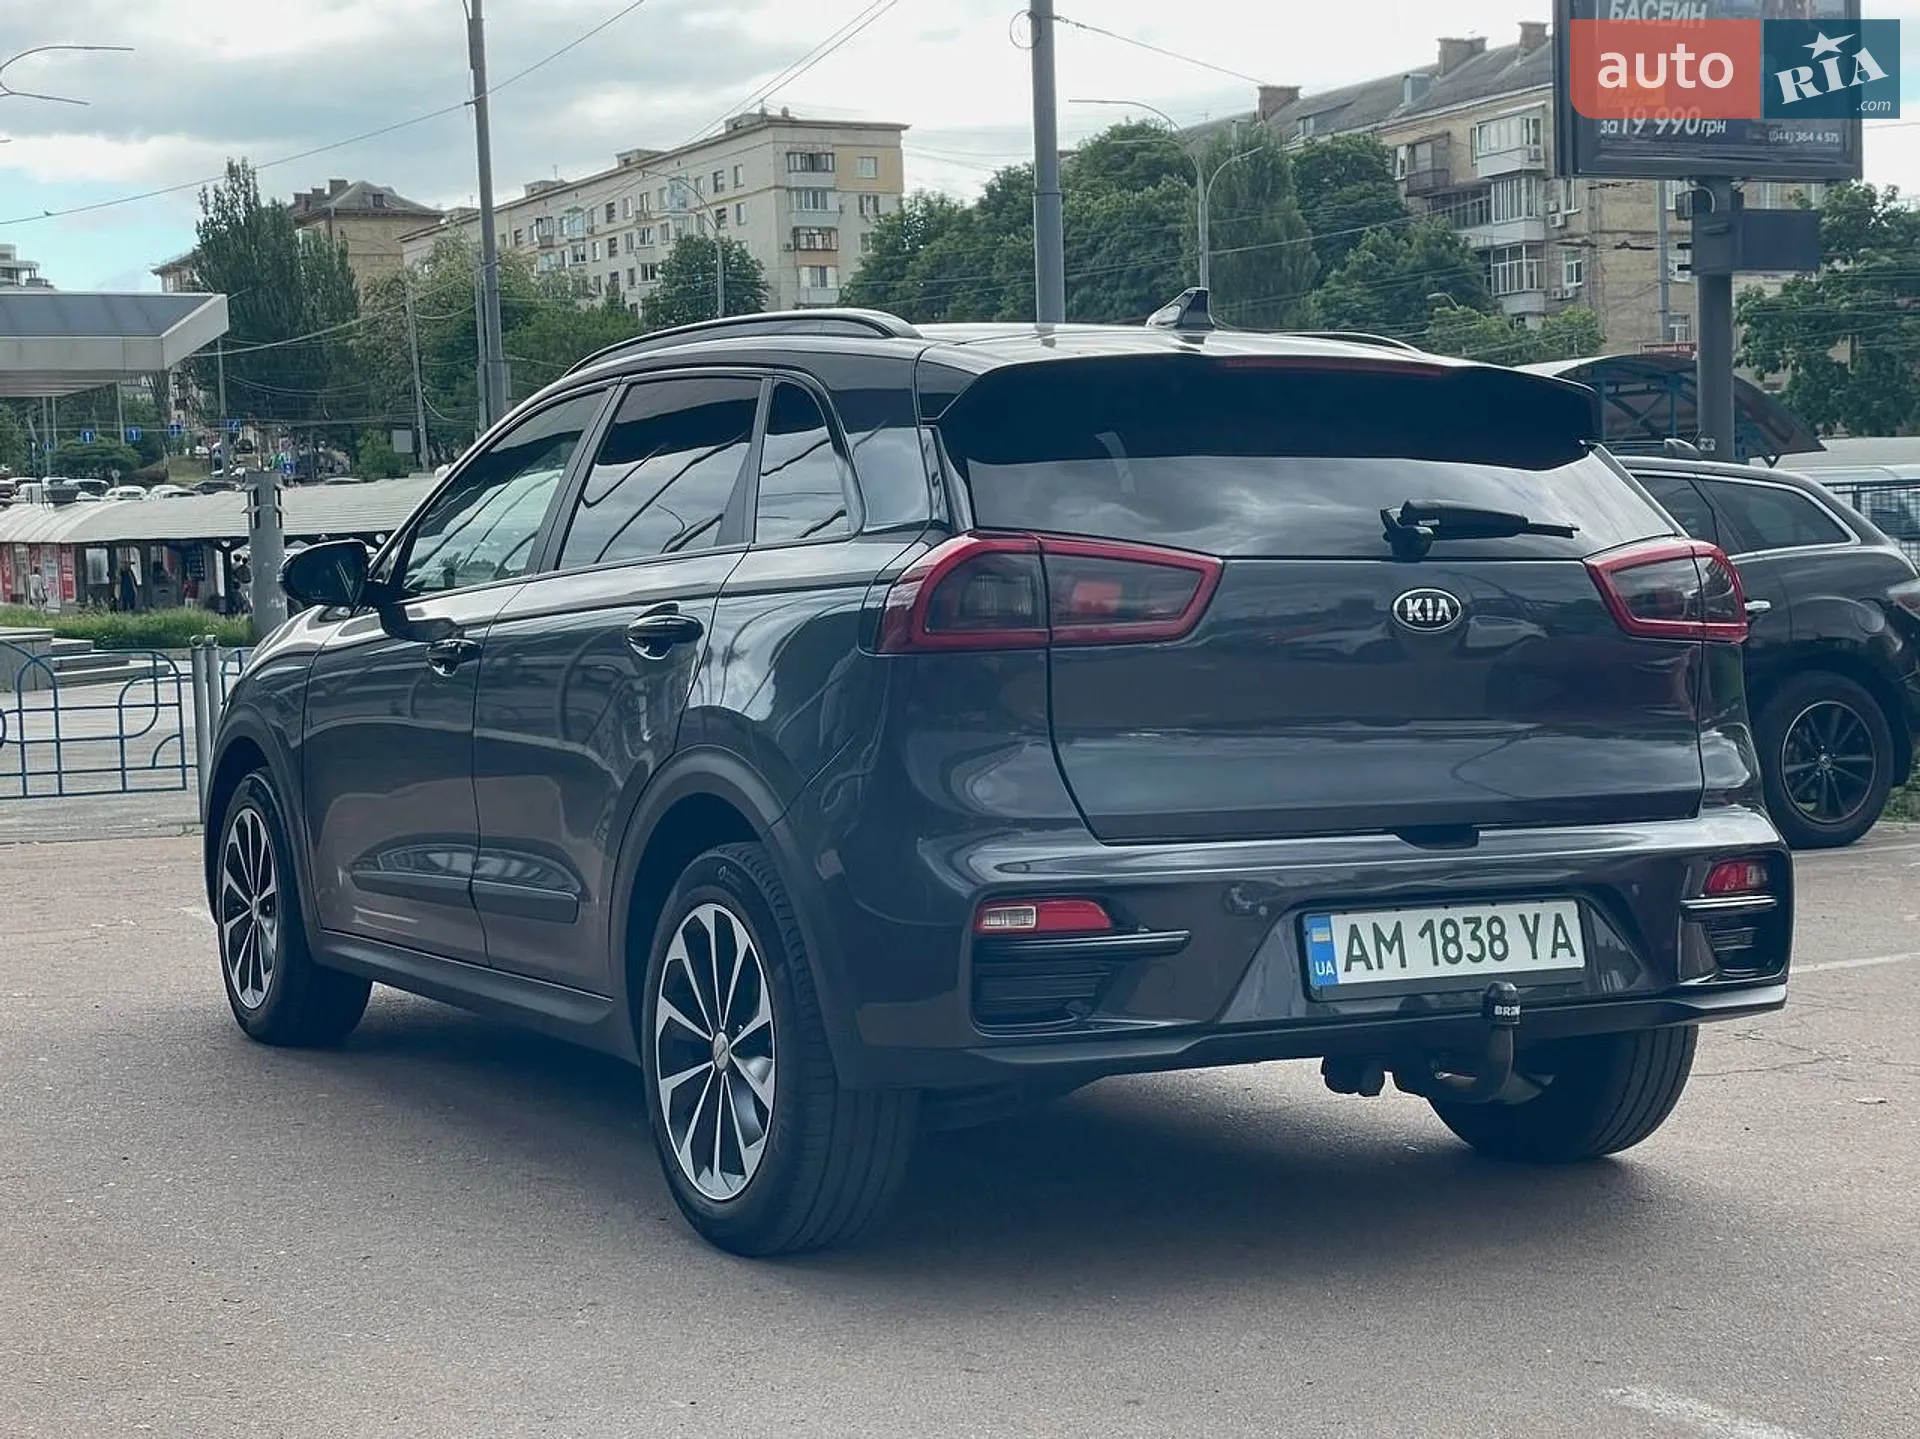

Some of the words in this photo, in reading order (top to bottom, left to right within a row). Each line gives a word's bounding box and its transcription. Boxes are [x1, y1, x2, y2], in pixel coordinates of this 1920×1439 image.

[1600, 120, 1618, 133] за
[1700, 119, 1727, 136] грн
[1405, 598, 1452, 621] KIA
[1344, 920, 1407, 972] AM
[1418, 916, 1509, 966] 1838
[1518, 912, 1577, 960] YA
[1315, 961, 1335, 976] UA
